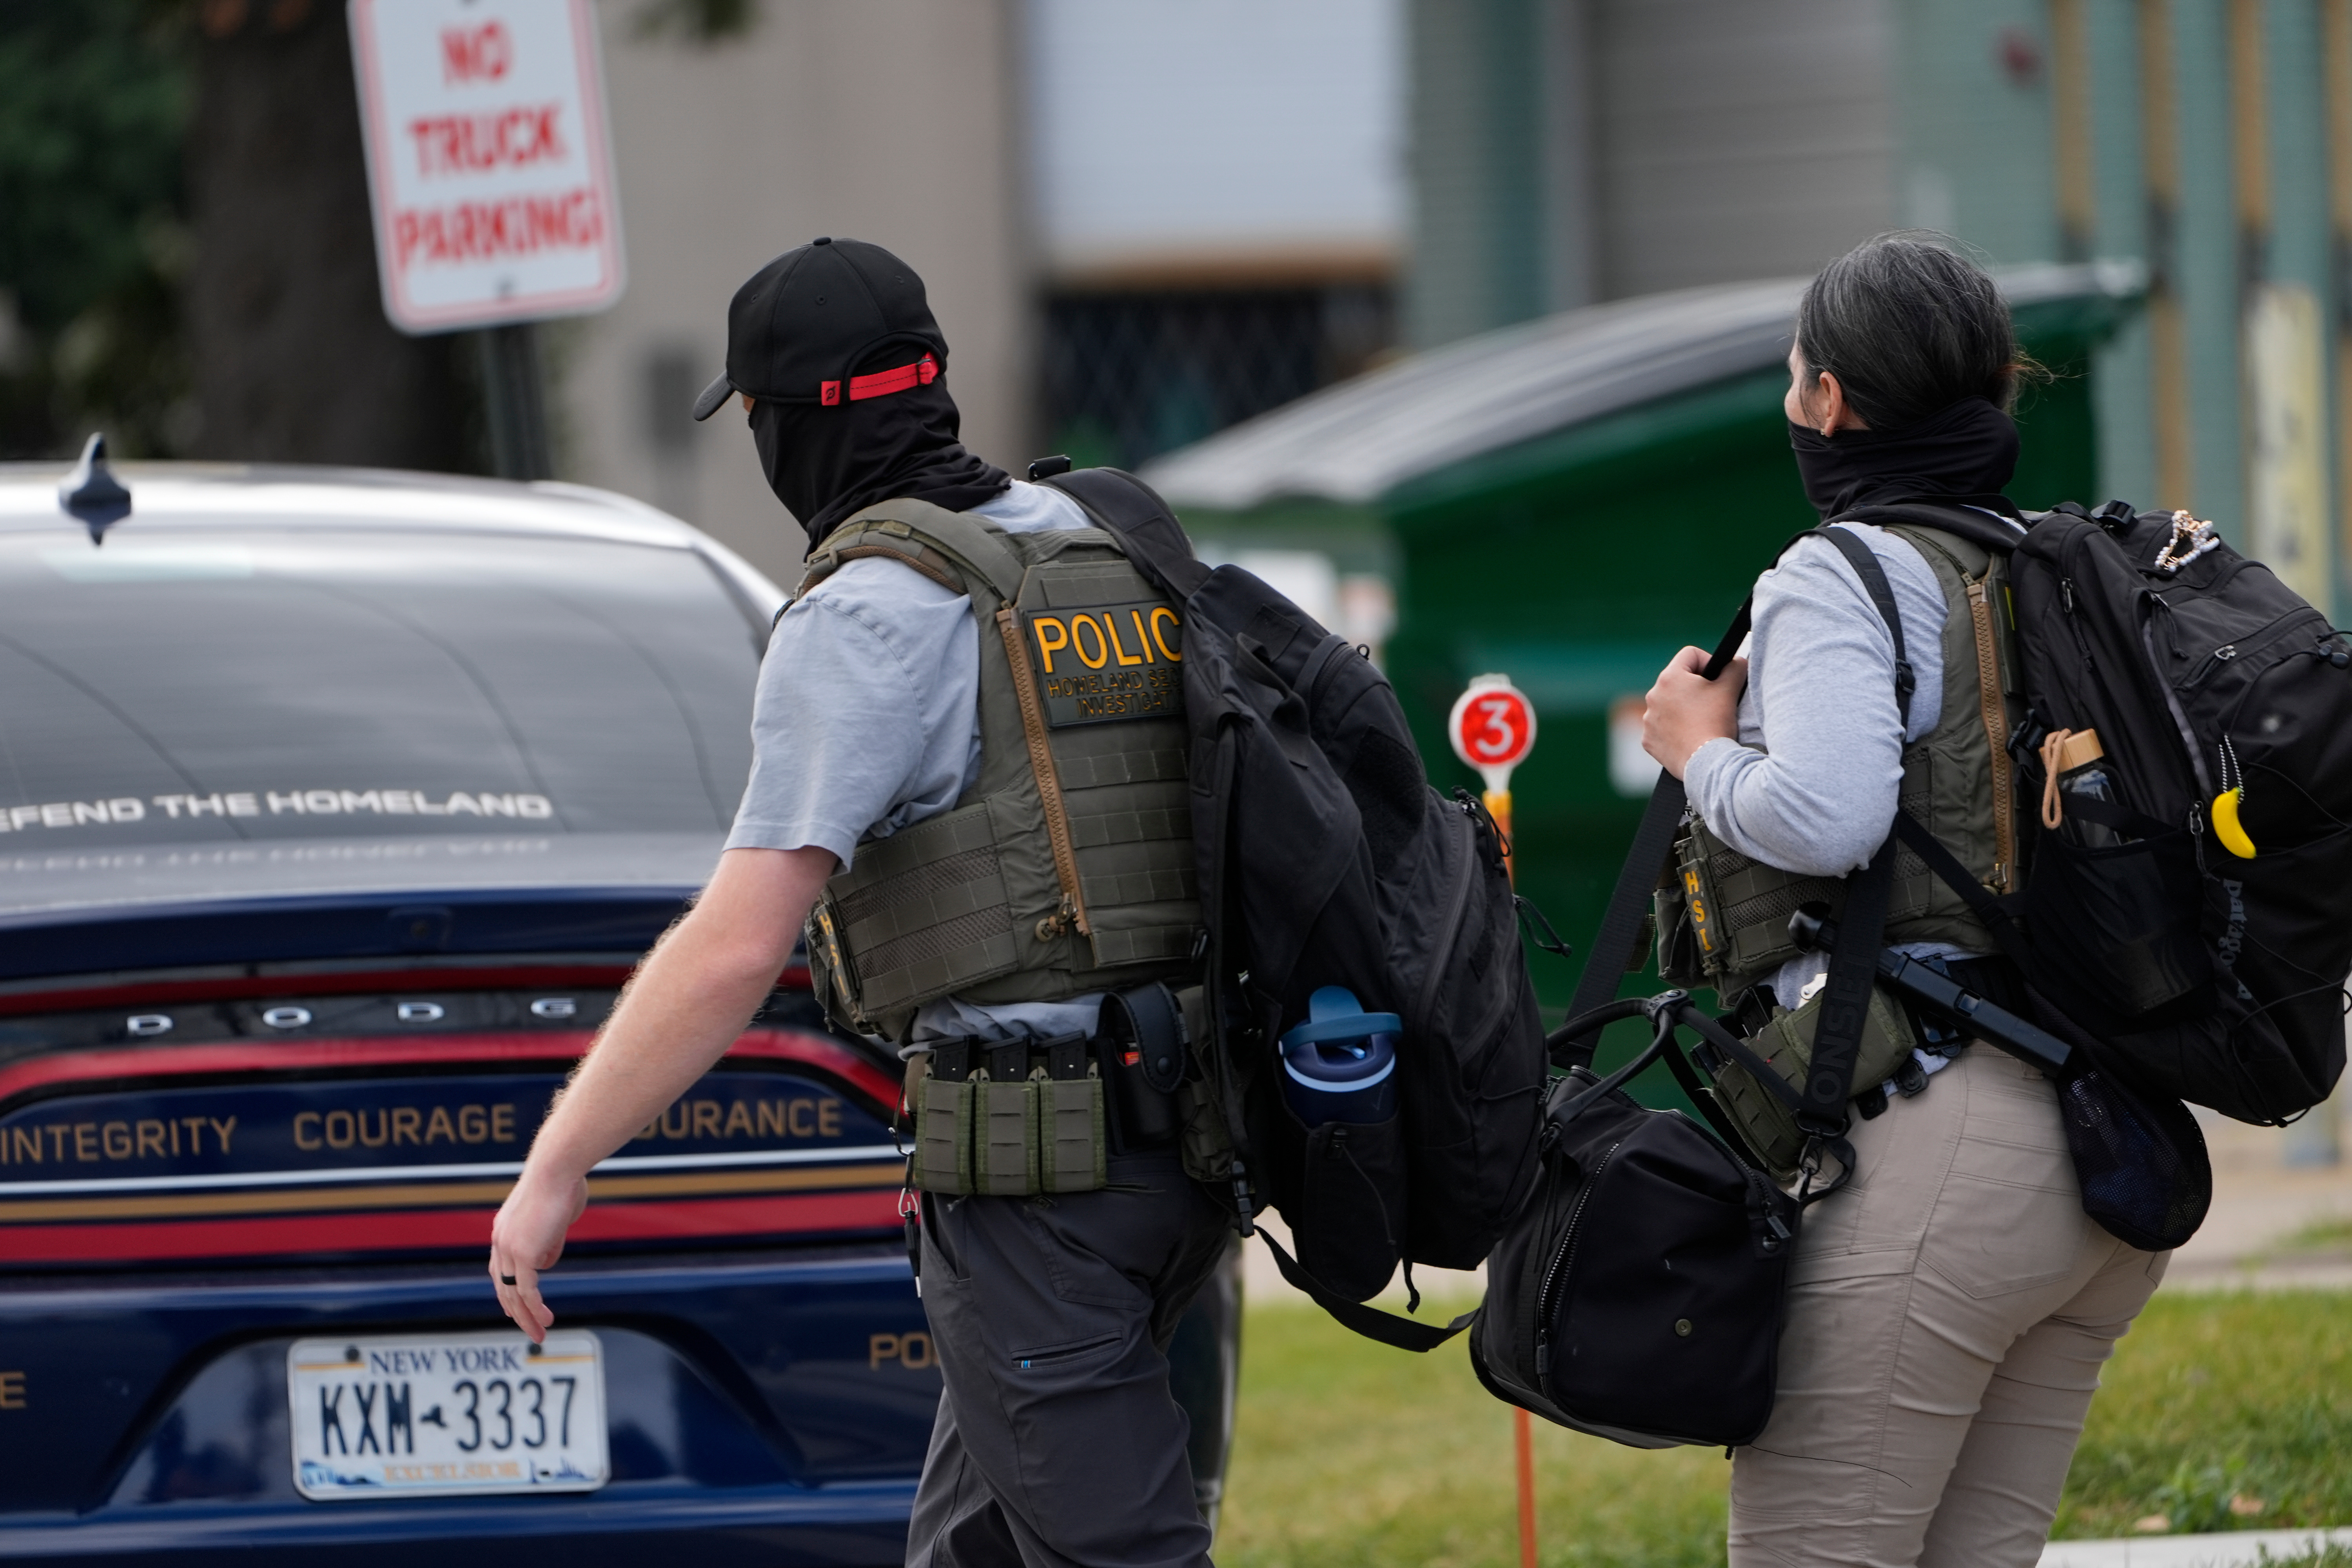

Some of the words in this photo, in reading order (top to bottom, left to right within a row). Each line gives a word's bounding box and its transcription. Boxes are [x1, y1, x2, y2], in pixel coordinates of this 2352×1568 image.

[441, 20, 515, 88] NO
[408, 102, 567, 179] TRUCK
[396, 191, 604, 271] PARKING
[1046, 671, 1143, 698] HOMELAND
[1475, 701, 1514, 757] 3
[154, 791, 260, 818] THE
[267, 789, 553, 819] HOMELAND
[1685, 870, 1711, 951] HSI
[818, 913, 847, 996] HSI
[1, 1116, 236, 1164] INTEGRITY
[293, 1103, 517, 1151] COURAGE
[370, 1348, 442, 1374] NEW
[444, 1346, 521, 1372] YORK
[870, 1331, 941, 1371] PO
[320, 1381, 413, 1456] KXM
[453, 1376, 578, 1452] 3337
